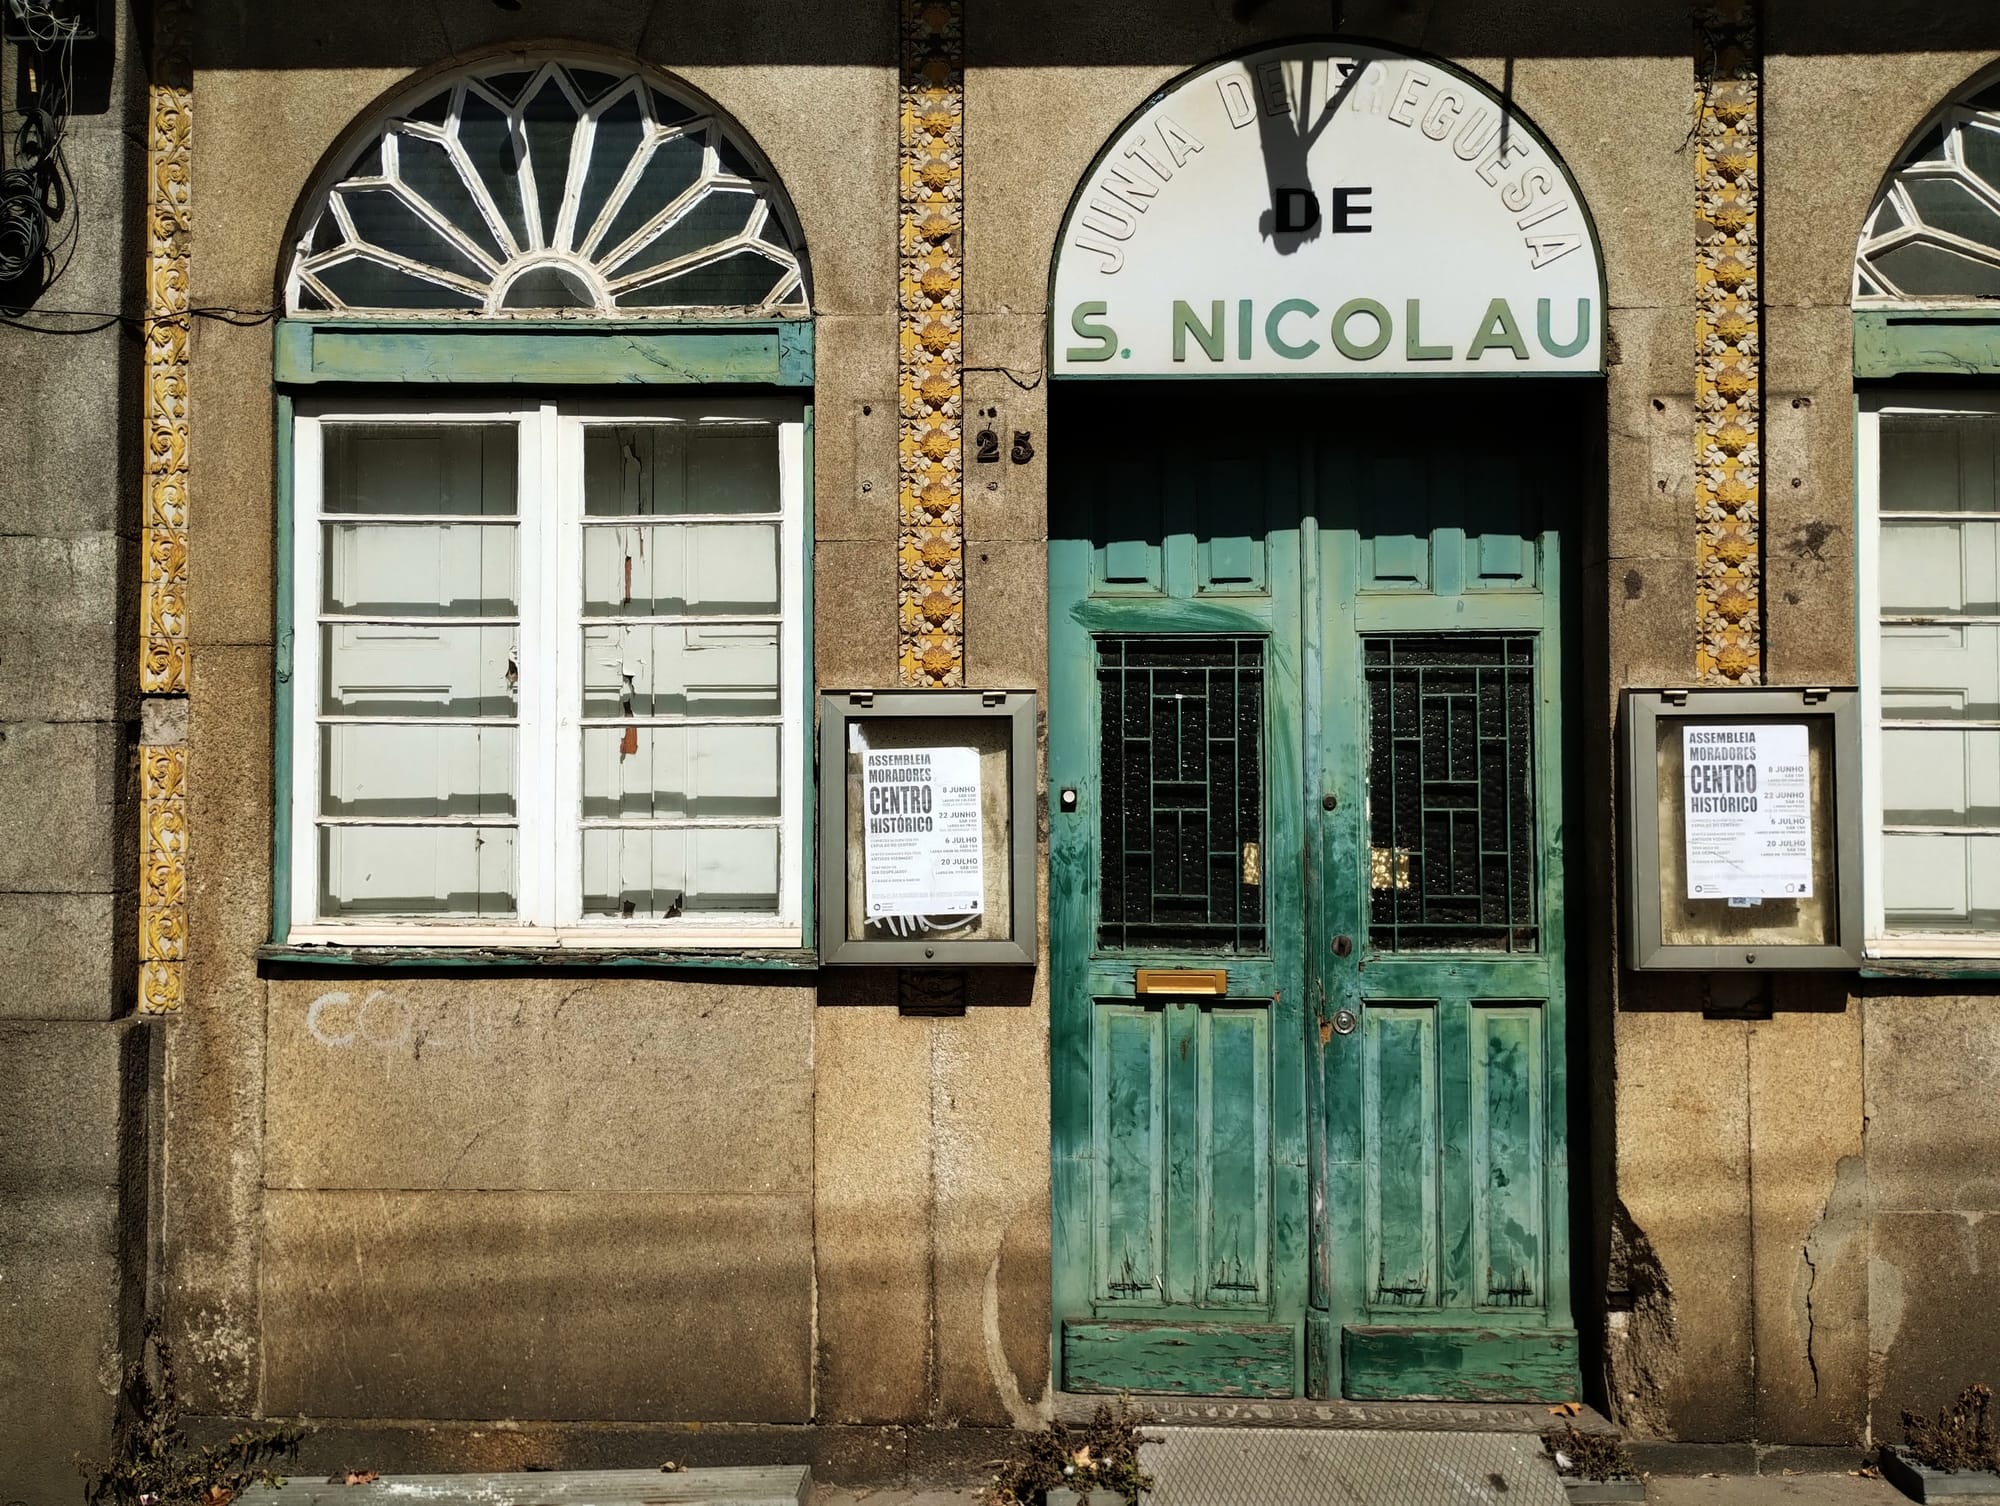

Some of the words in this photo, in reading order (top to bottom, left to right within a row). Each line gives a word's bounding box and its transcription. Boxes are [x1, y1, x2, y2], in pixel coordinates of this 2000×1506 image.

[1075, 114, 1204, 274] JUNTA
[1216, 60, 1291, 129] DE
[1326, 56, 1581, 269] FREGUESIA
[1275, 187, 1372, 233] DE
[1066, 300, 1132, 361] S.
[1172, 298, 1591, 361] NICOLAU
[1689, 732, 1756, 744] ASSEMBLEIA
[868, 754, 931, 767] ASSEMBLEIA
[1690, 746, 1757, 761] MORADORES
[869, 768, 932, 783] MORADORES
[1690, 763, 1757, 794] CENTRO
[869, 785, 932, 816] CENTRO
[1691, 794, 1758, 813] HISTÓRICO
[950, 811, 977, 819] JUNHO
[870, 814, 933, 834] HISTÓRICO
[952, 836, 978, 844] JULHO
[1778, 839, 1806, 847] JULHO
[952, 857, 978, 865] JULHO
